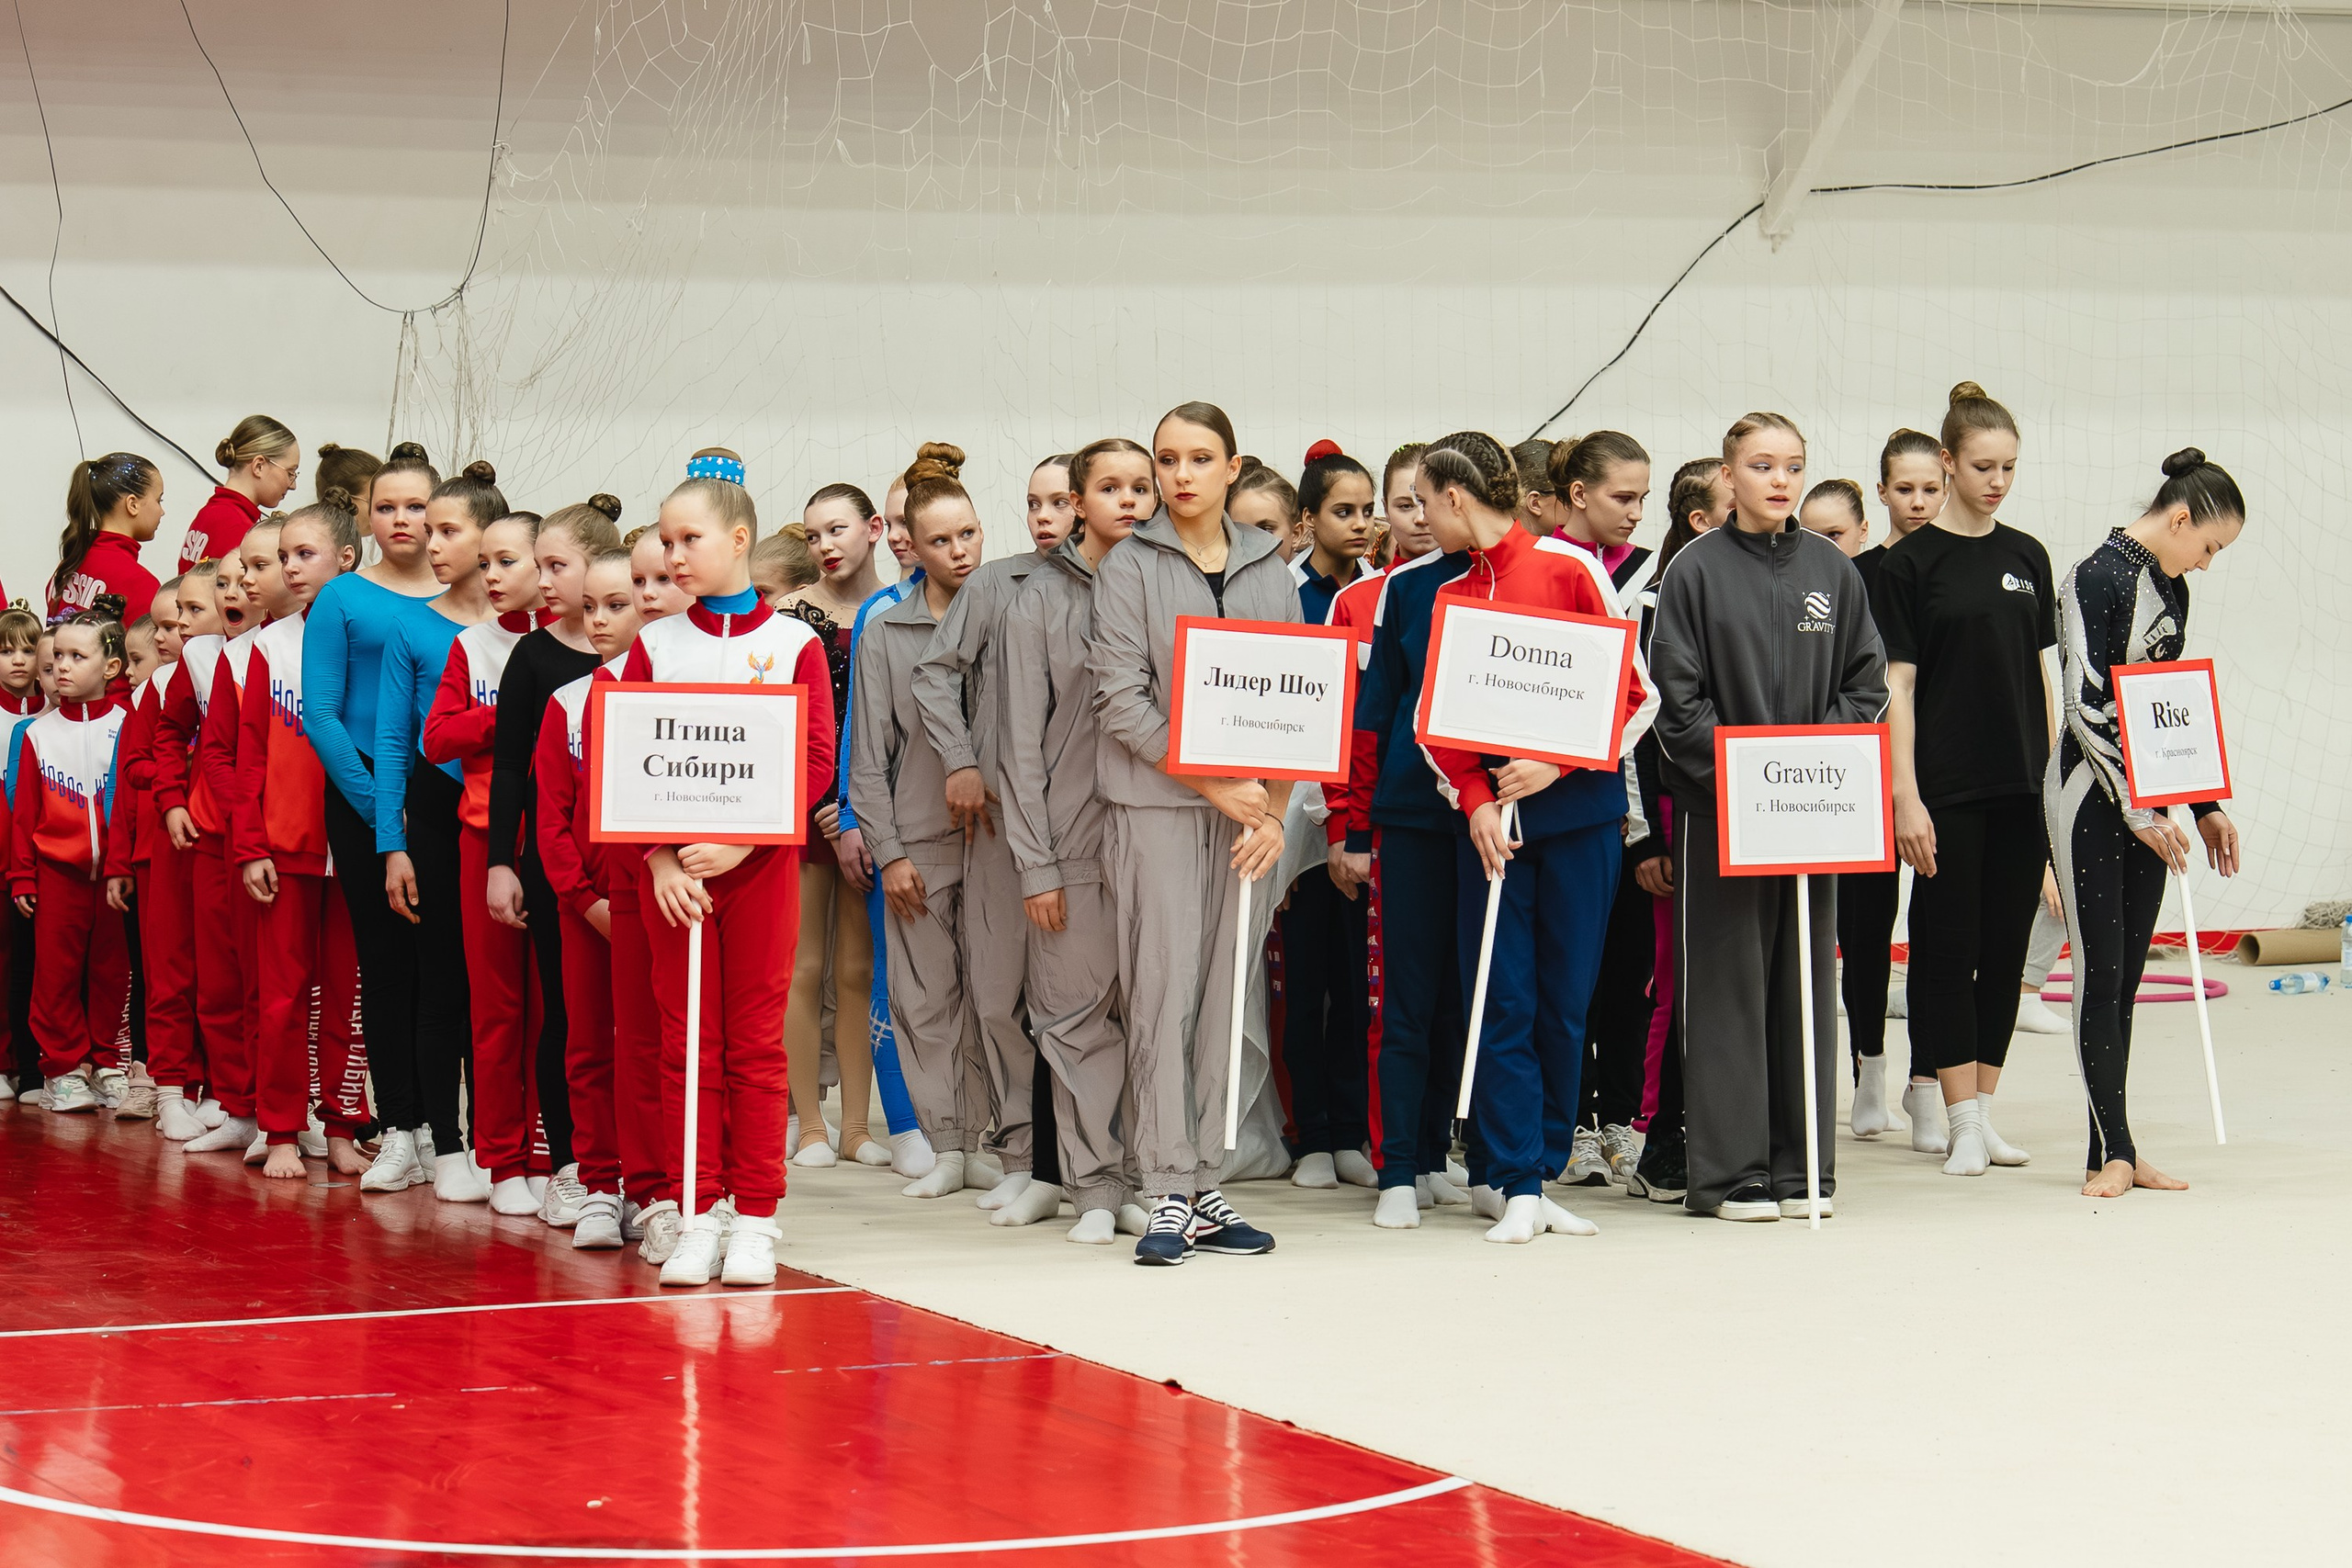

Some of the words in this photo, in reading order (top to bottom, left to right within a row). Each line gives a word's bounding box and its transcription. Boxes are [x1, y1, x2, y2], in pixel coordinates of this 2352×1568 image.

[1797, 621, 1836, 635] GRAVITY
[1488, 634, 1573, 669] Donna
[1204, 666, 1272, 697] Лидер
[1279, 673, 1329, 703] Шоу
[1468, 673, 1479, 685] г.
[1485, 672, 1586, 701] Новосибирск
[1221, 716, 1229, 727] г.
[1233, 715, 1306, 735] Новосибирск
[2151, 701, 2191, 728] Rise
[653, 717, 746, 745] Птица
[2161, 747, 2199, 761] Красноярск
[643, 753, 754, 785] Сибири
[1763, 761, 1847, 790] Gravity
[654, 793, 663, 802] г.
[667, 791, 742, 806] Новосибирск
[1756, 803, 1766, 813] г.
[1770, 799, 1856, 816] Новосибирск
